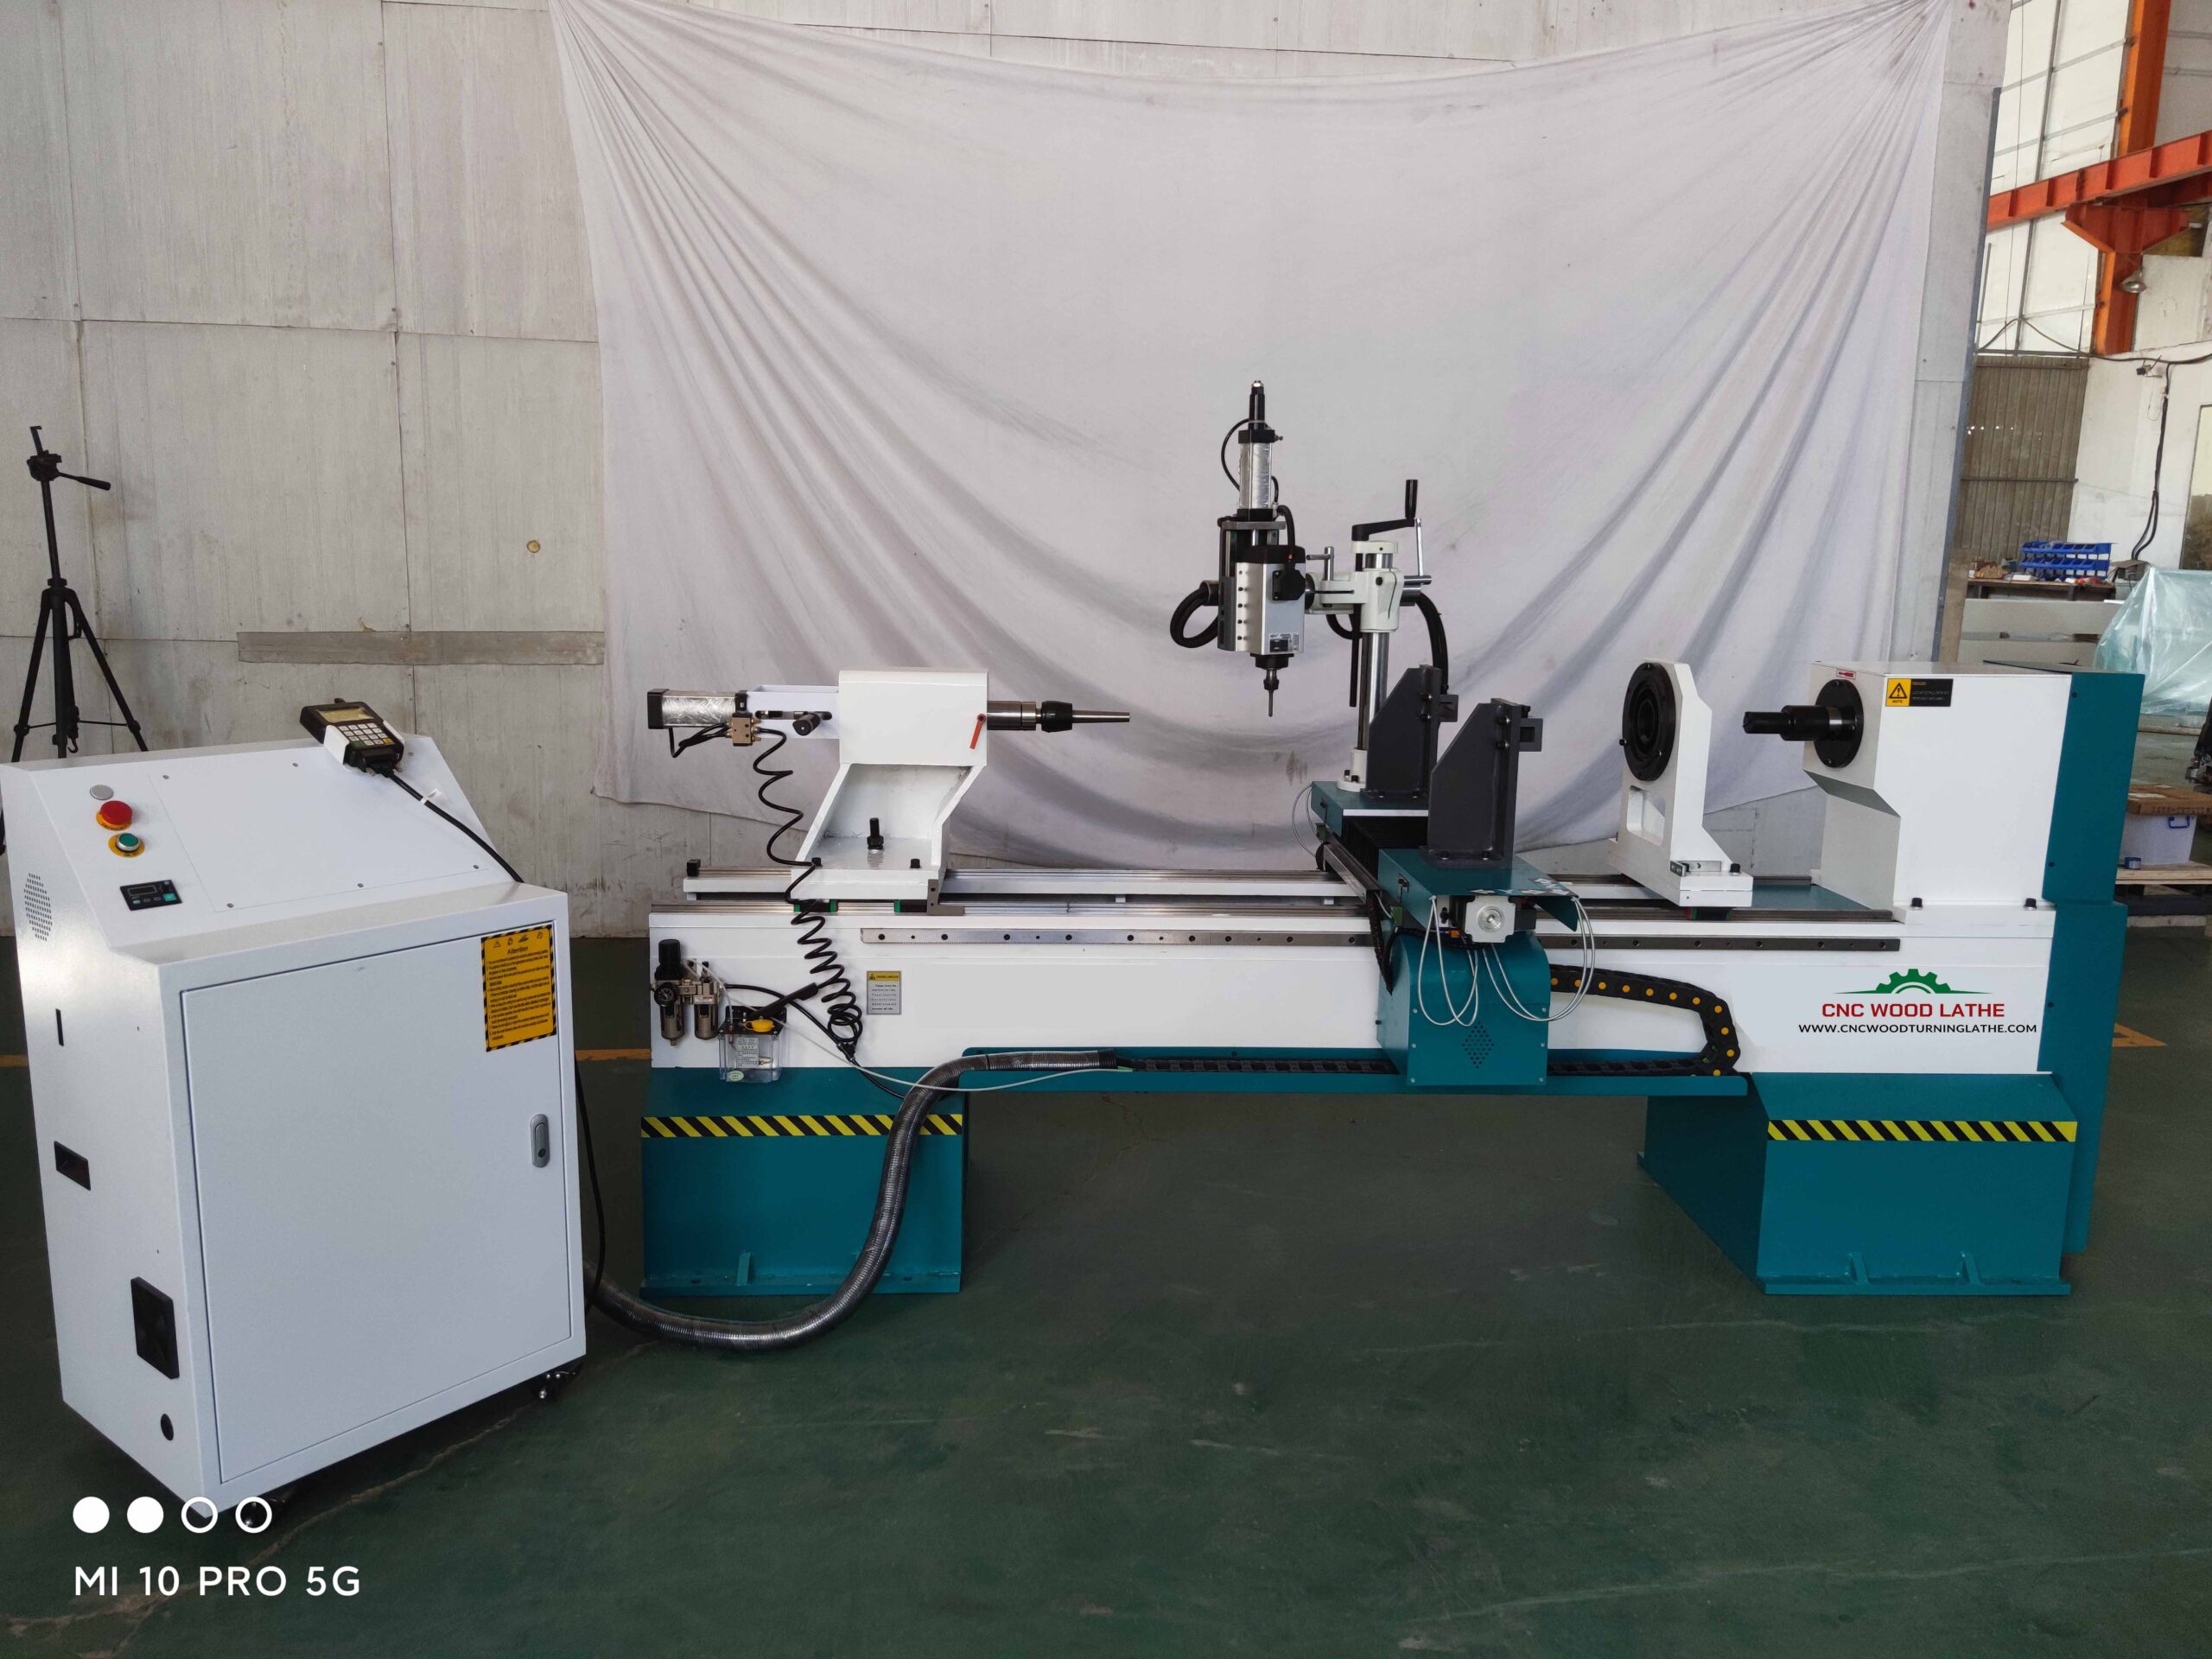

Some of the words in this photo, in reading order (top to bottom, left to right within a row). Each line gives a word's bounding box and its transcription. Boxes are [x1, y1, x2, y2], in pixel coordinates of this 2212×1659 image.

[507, 946, 529, 955] Attention
[1821, 1003, 1864, 1018] CNC
[1870, 1003, 1934, 1018] WOOD
[1939, 1003, 2005, 1018] LATHE
[1798, 1024, 2037, 1033] WWW.CNCWOODTURNINGLATHE.COM
